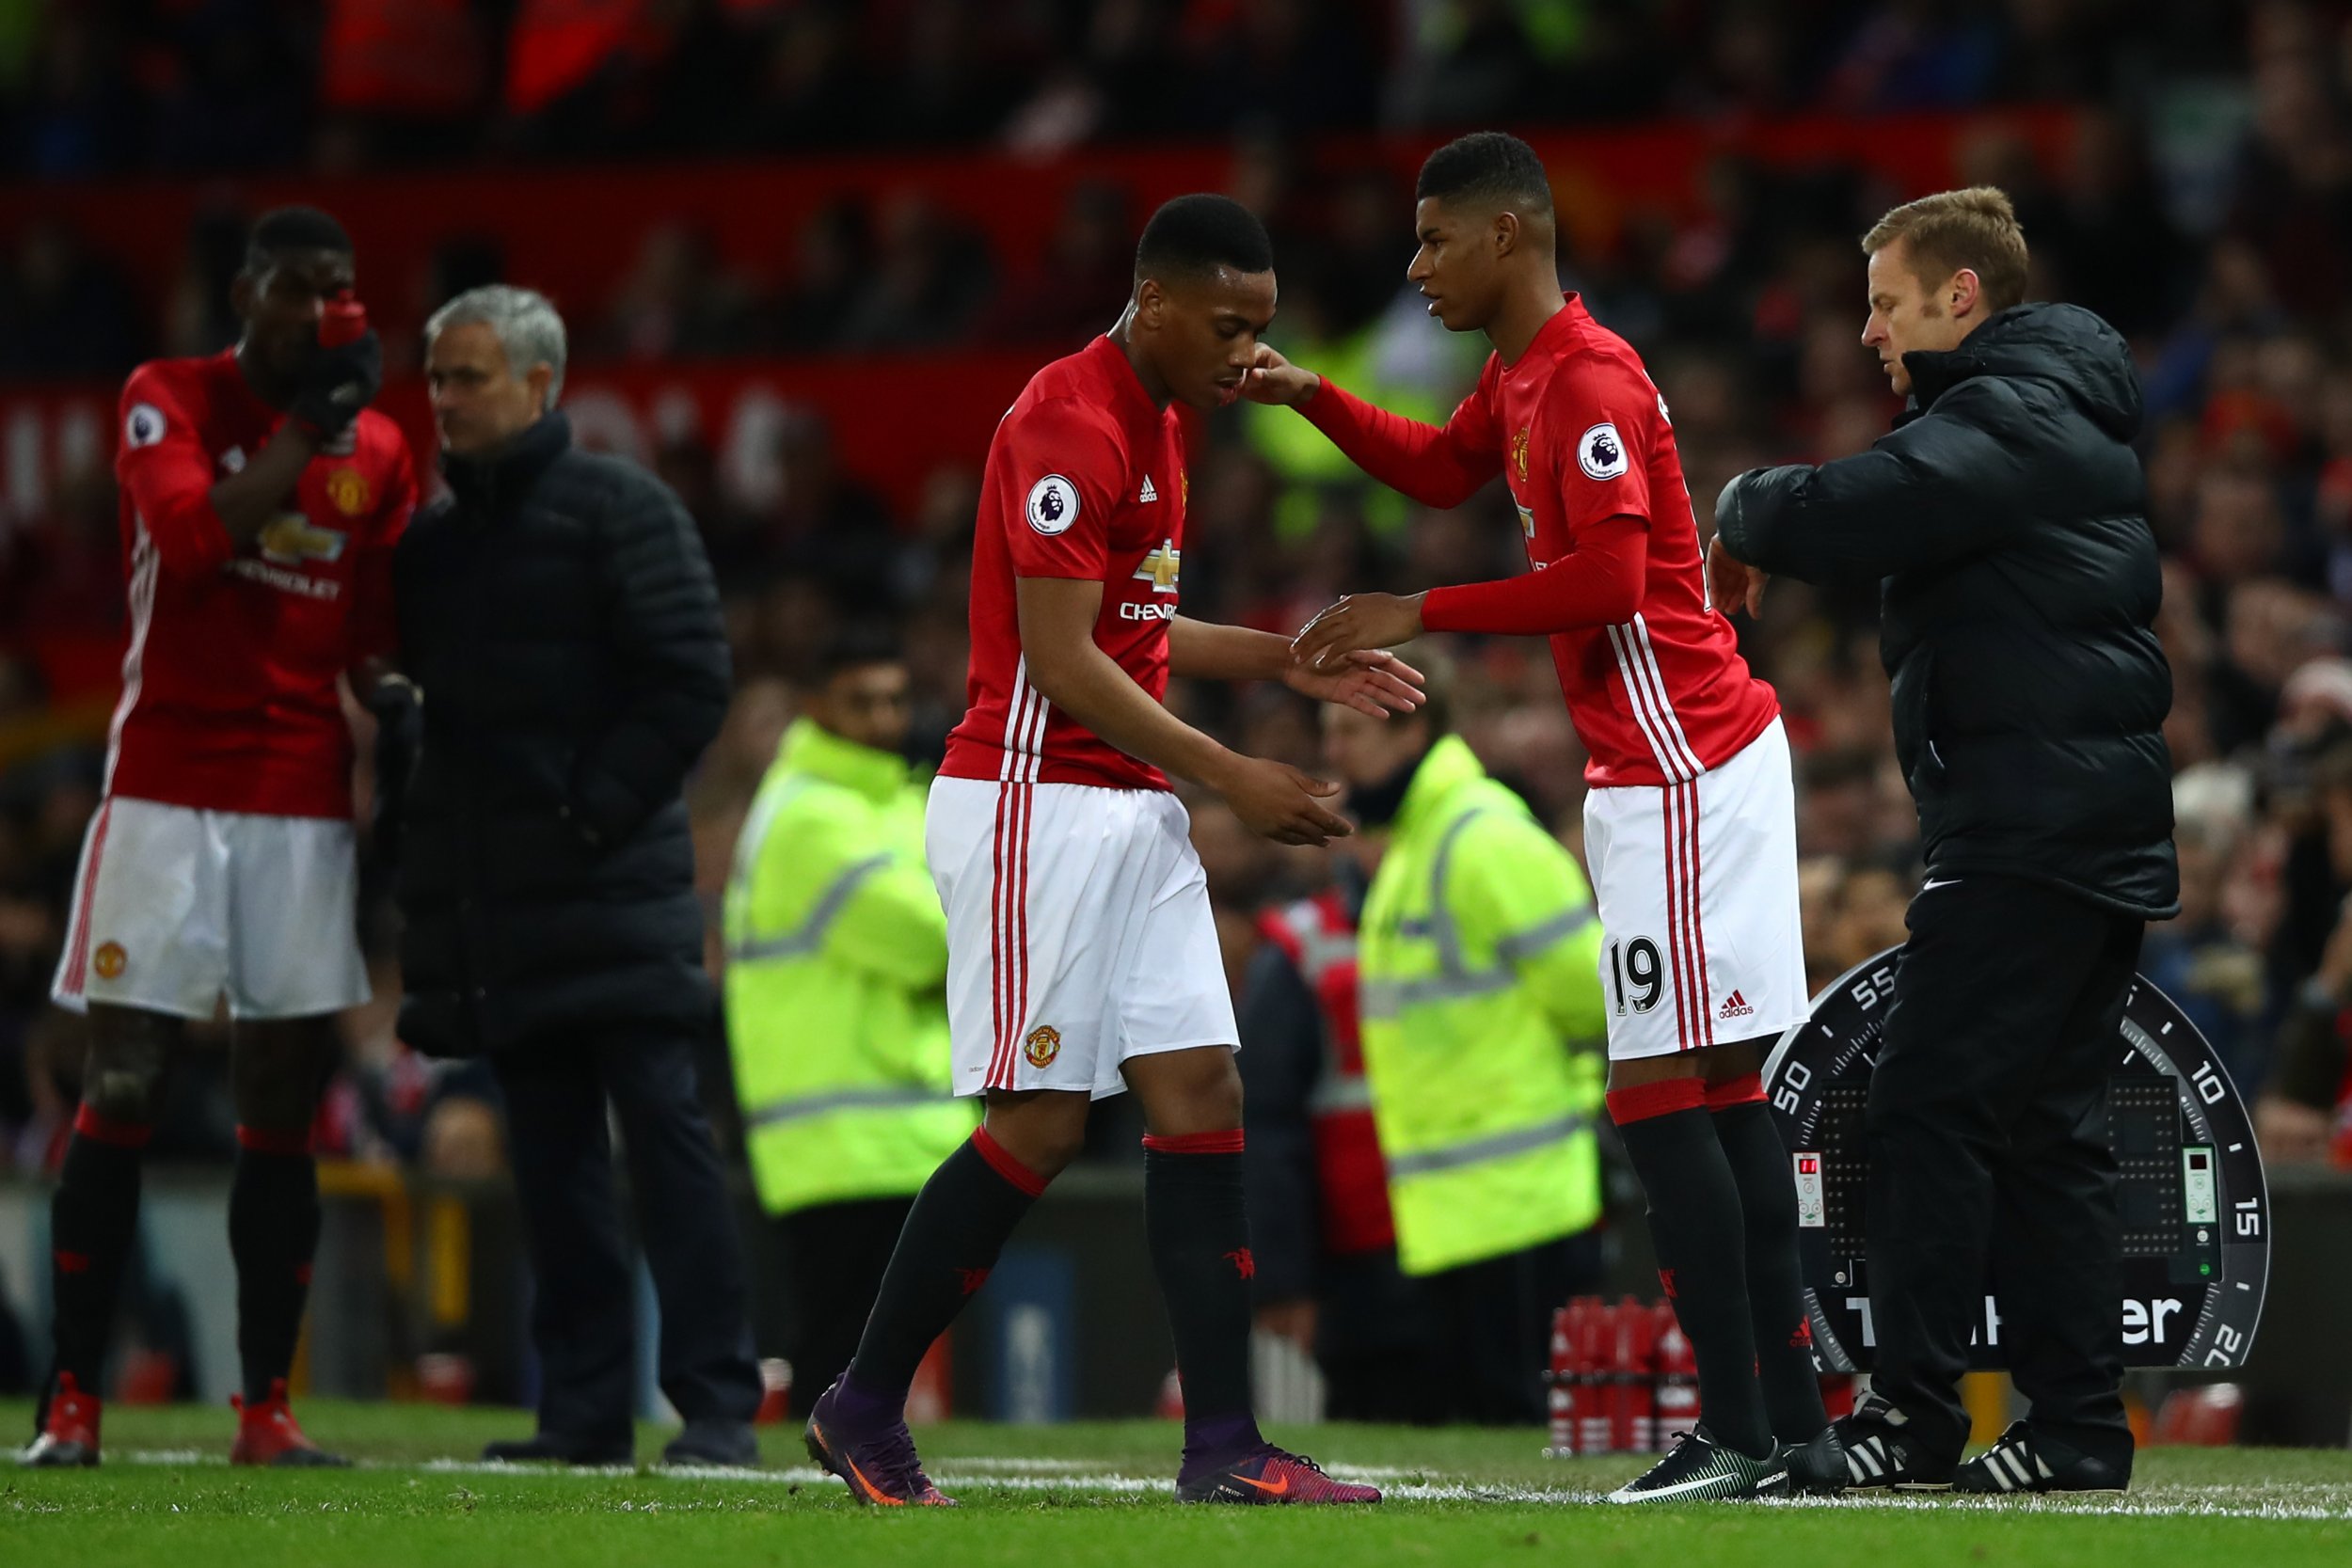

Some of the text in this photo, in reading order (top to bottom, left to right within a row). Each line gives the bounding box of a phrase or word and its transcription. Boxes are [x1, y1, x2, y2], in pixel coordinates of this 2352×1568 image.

[1610, 935, 1665, 1017] 19
[1851, 966, 1895, 1011] 55
[1719, 1006, 1754, 1020] adidas
[1773, 1060, 1812, 1116] 50
[2191, 1060, 2225, 1104] 10
[1802, 1160, 1817, 1173] 11
[2235, 1197, 2260, 1236] 15
